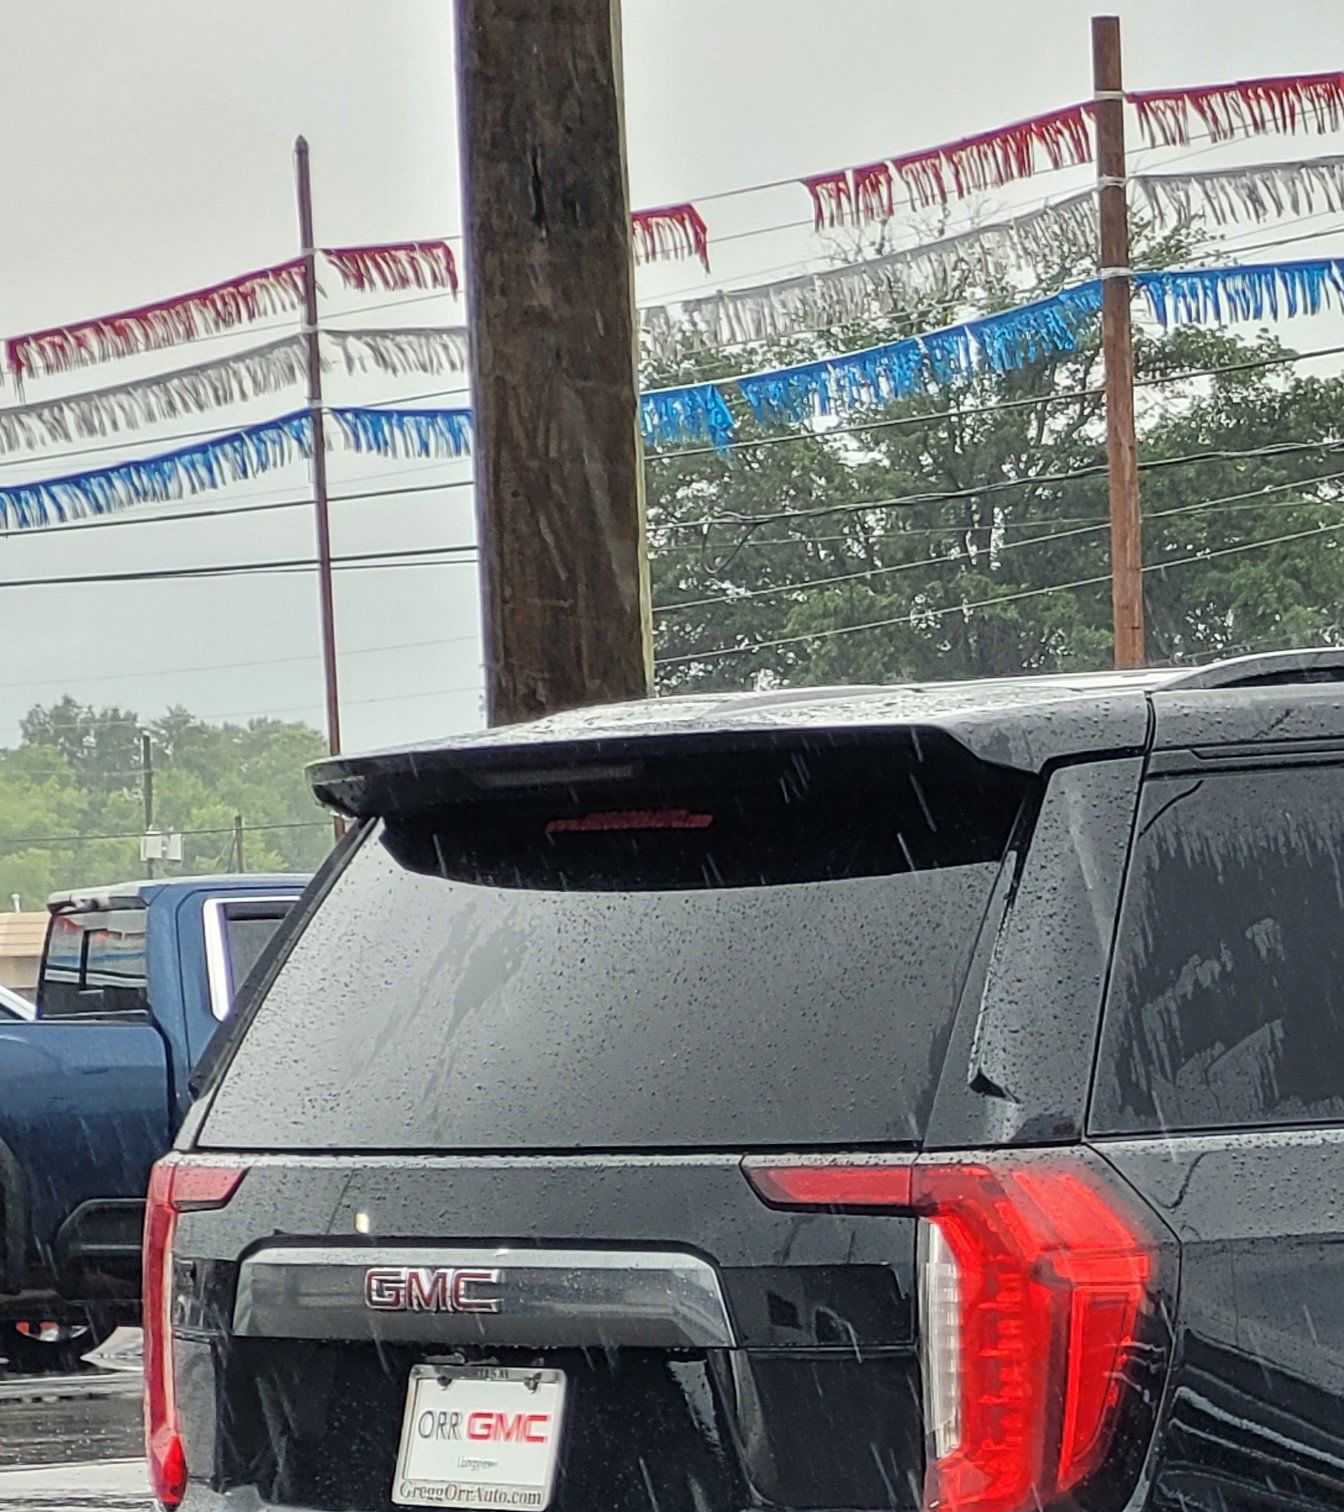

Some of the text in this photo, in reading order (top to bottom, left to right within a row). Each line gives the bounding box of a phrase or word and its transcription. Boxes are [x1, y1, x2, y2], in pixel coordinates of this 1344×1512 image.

[364, 1267, 502, 1313] GMC
[417, 1410, 549, 1443] ORR GMC
[399, 1480, 543, 1506] GreggOrrAuto.com
